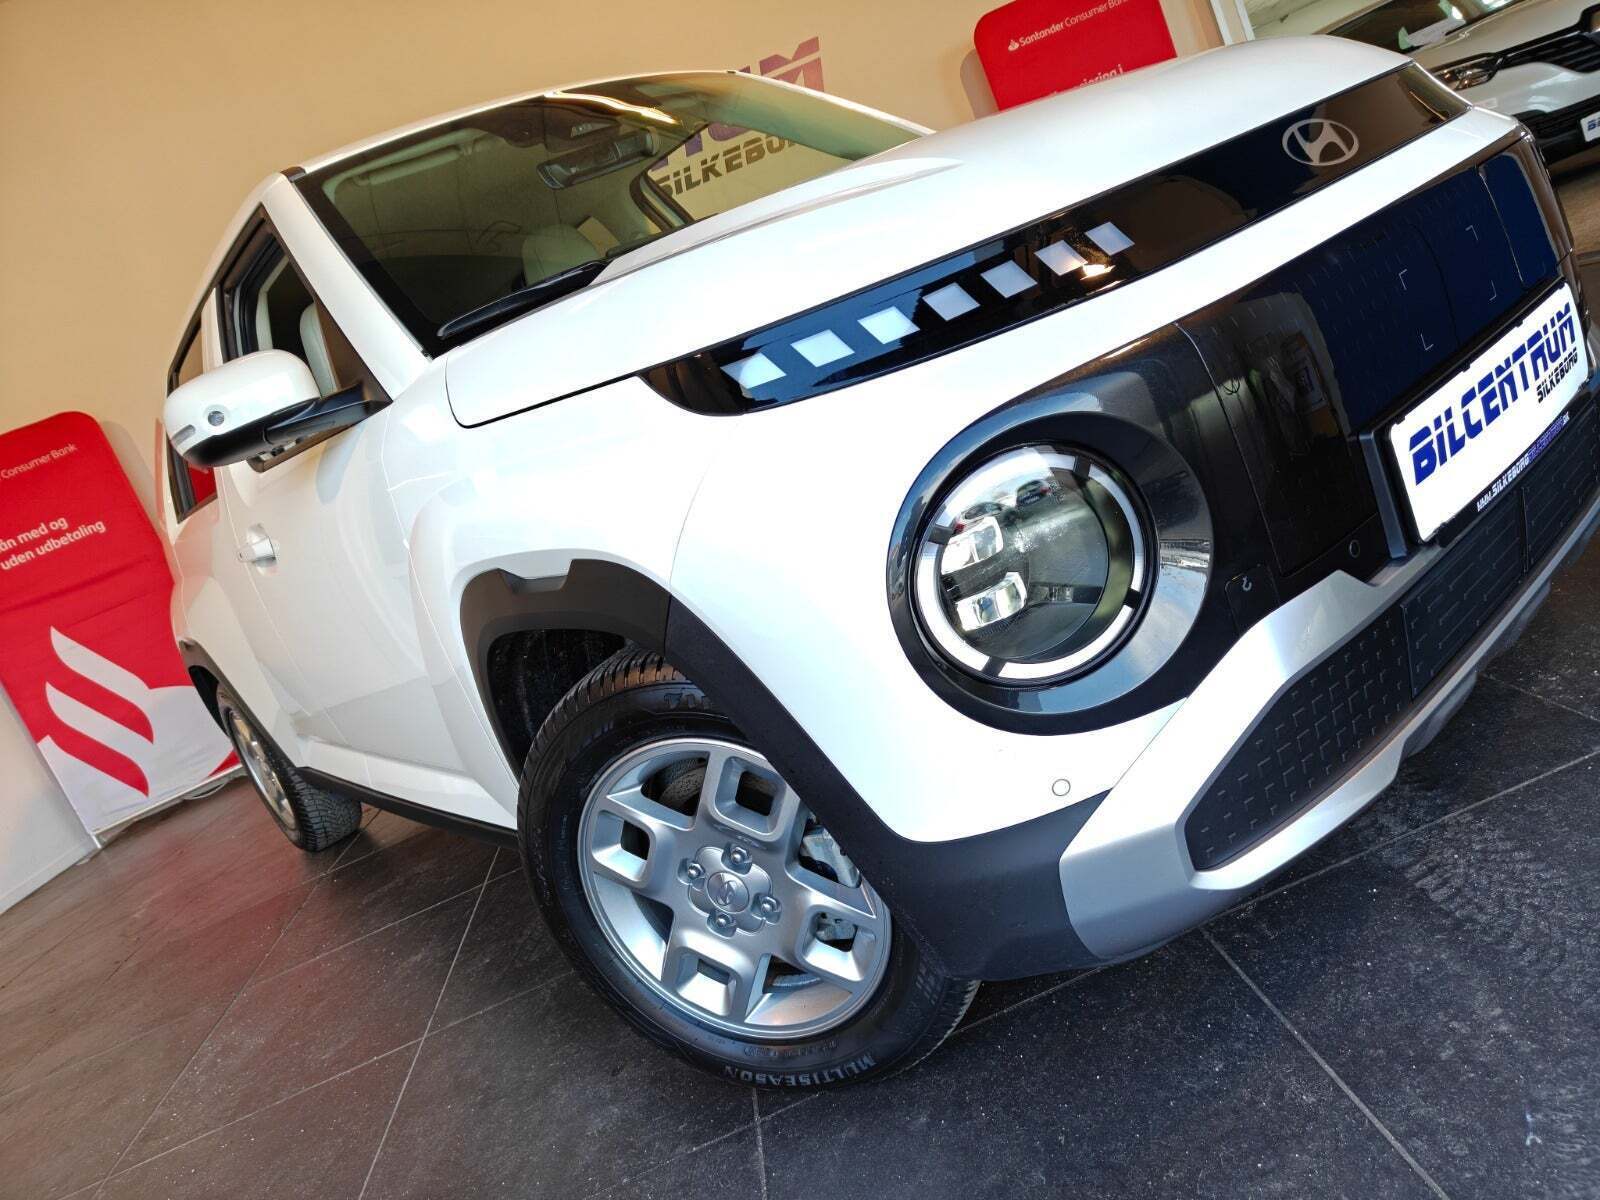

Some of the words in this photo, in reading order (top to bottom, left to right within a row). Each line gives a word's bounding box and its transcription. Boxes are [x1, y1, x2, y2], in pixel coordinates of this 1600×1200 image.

[1019, 21, 1064, 48] Santander
[1065, 3, 1108, 27] Consumer
[653, 134, 795, 196] SILKEBO
[1408, 302, 1576, 486] BILCENTRUM
[1536, 346, 1578, 404] SILKEBORG
[0, 454, 50, 479] Consumer
[50, 442, 77, 460] Bank
[1, 550, 36, 571] uden
[35, 520, 106, 556] udbetaling
[17, 523, 48, 544] med
[49, 517, 69, 531] og
[724, 1053, 877, 1086] MULTISEASON
